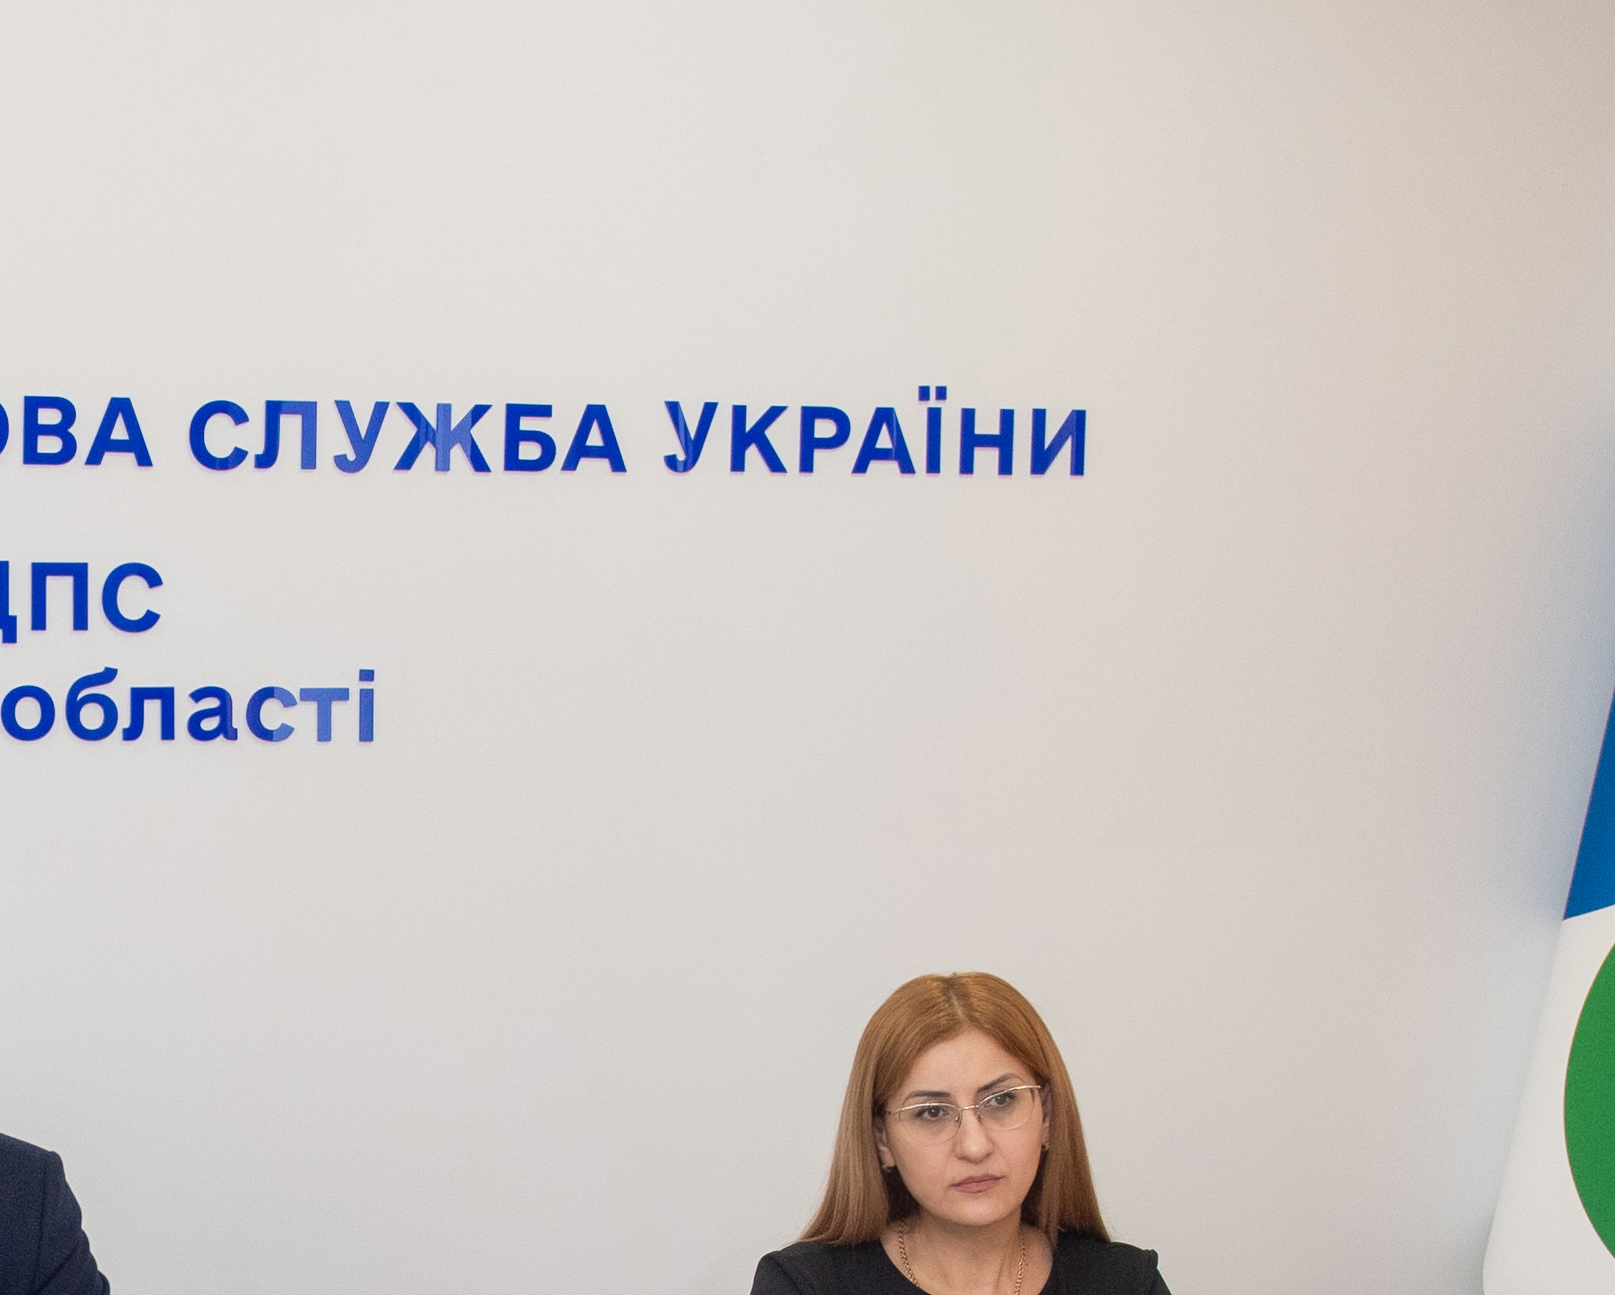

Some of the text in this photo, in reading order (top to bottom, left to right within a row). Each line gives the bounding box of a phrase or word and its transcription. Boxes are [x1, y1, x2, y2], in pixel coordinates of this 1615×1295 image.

[184, 396, 627, 472] СЛУЖБА
[659, 385, 1089, 477] УКРАЇНИ
[0, 666, 379, 744] області
